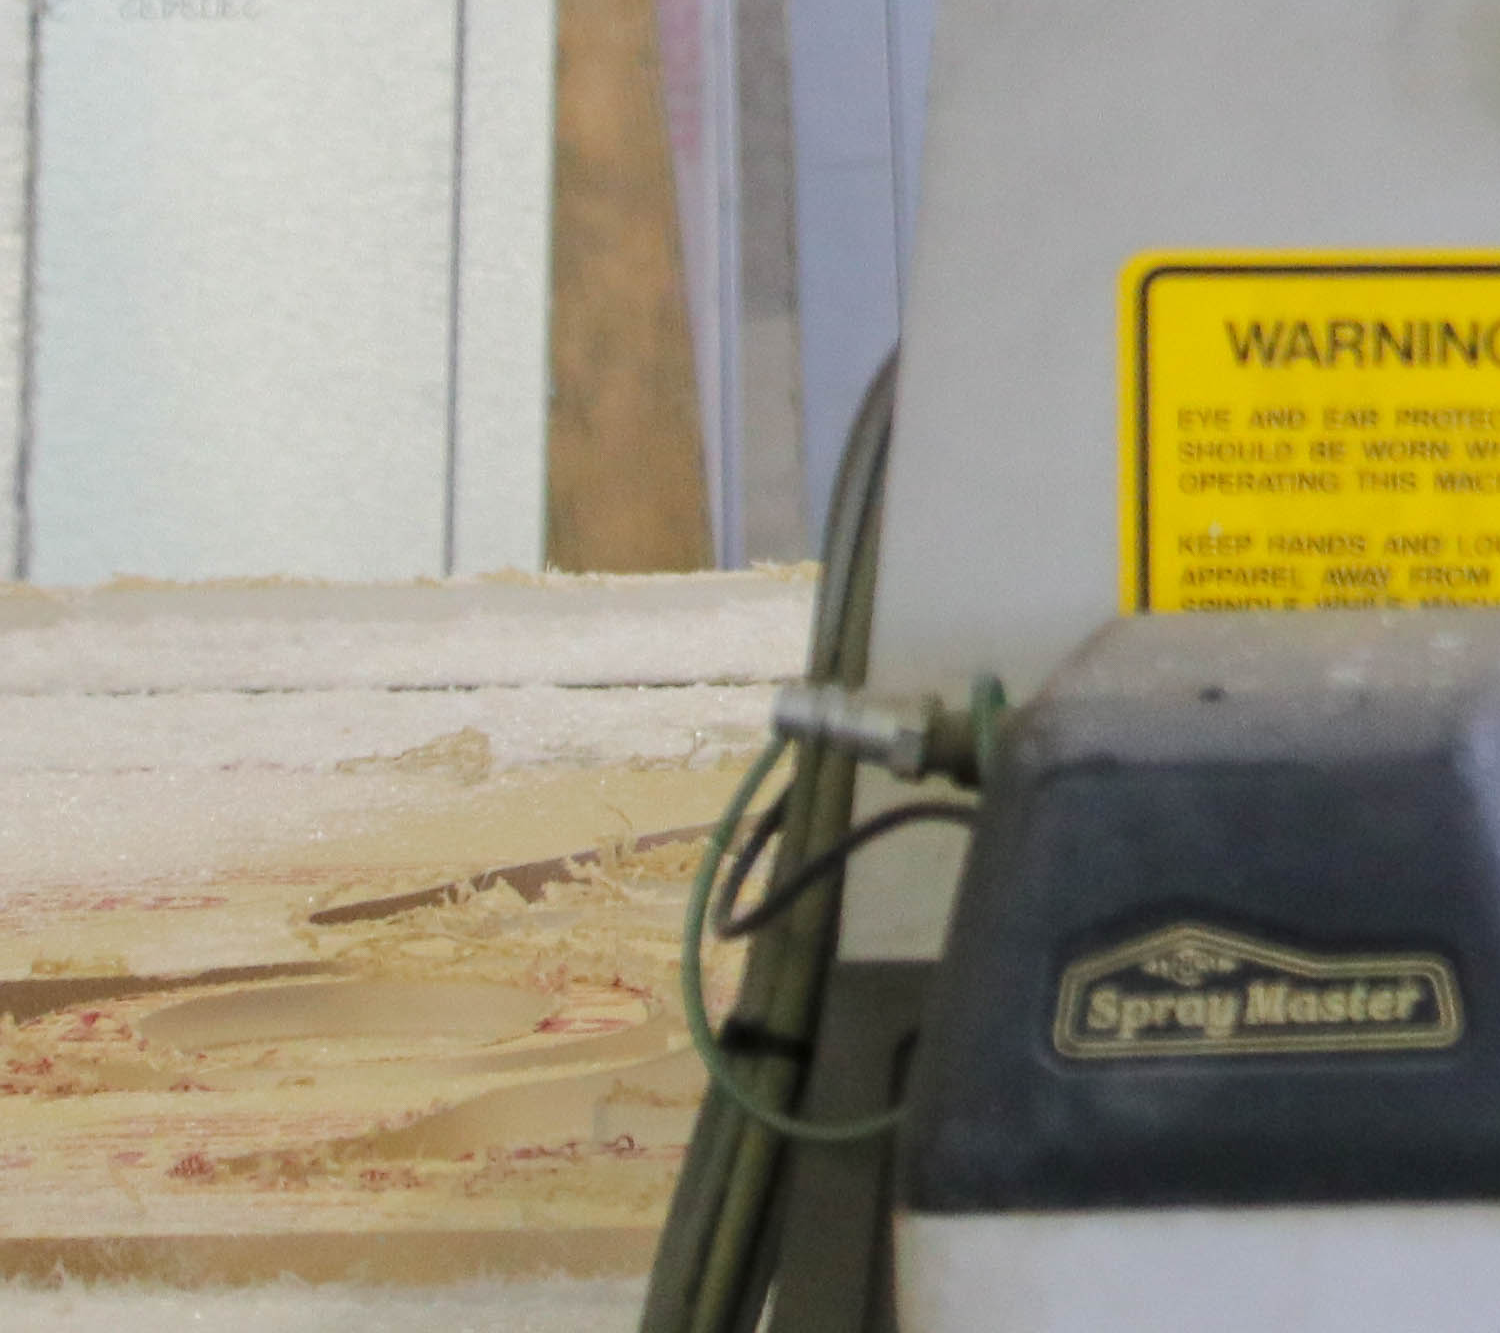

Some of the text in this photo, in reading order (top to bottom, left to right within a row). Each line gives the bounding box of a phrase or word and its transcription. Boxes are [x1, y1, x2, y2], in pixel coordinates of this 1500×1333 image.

[1177, 405, 1231, 430] EYE
[1249, 405, 1306, 430] AND
[1322, 405, 1379, 429] EAR
[1178, 438, 1294, 463] SHOULD
[1307, 438, 1345, 462] BE
[1362, 438, 1452, 463] WORN
[1178, 469, 1342, 494] OPERATING
[1357, 469, 1418, 493] THIS
[1178, 533, 1252, 556] KEEP
[1266, 533, 1366, 556] HANDS
[1383, 533, 1442, 556] AND
[1179, 564, 1299, 589] APPAREL
[1323, 564, 1391, 588] AWAY
[1409, 564, 1494, 588] FROM
[1086, 977, 1422, 1039] Spray Master
